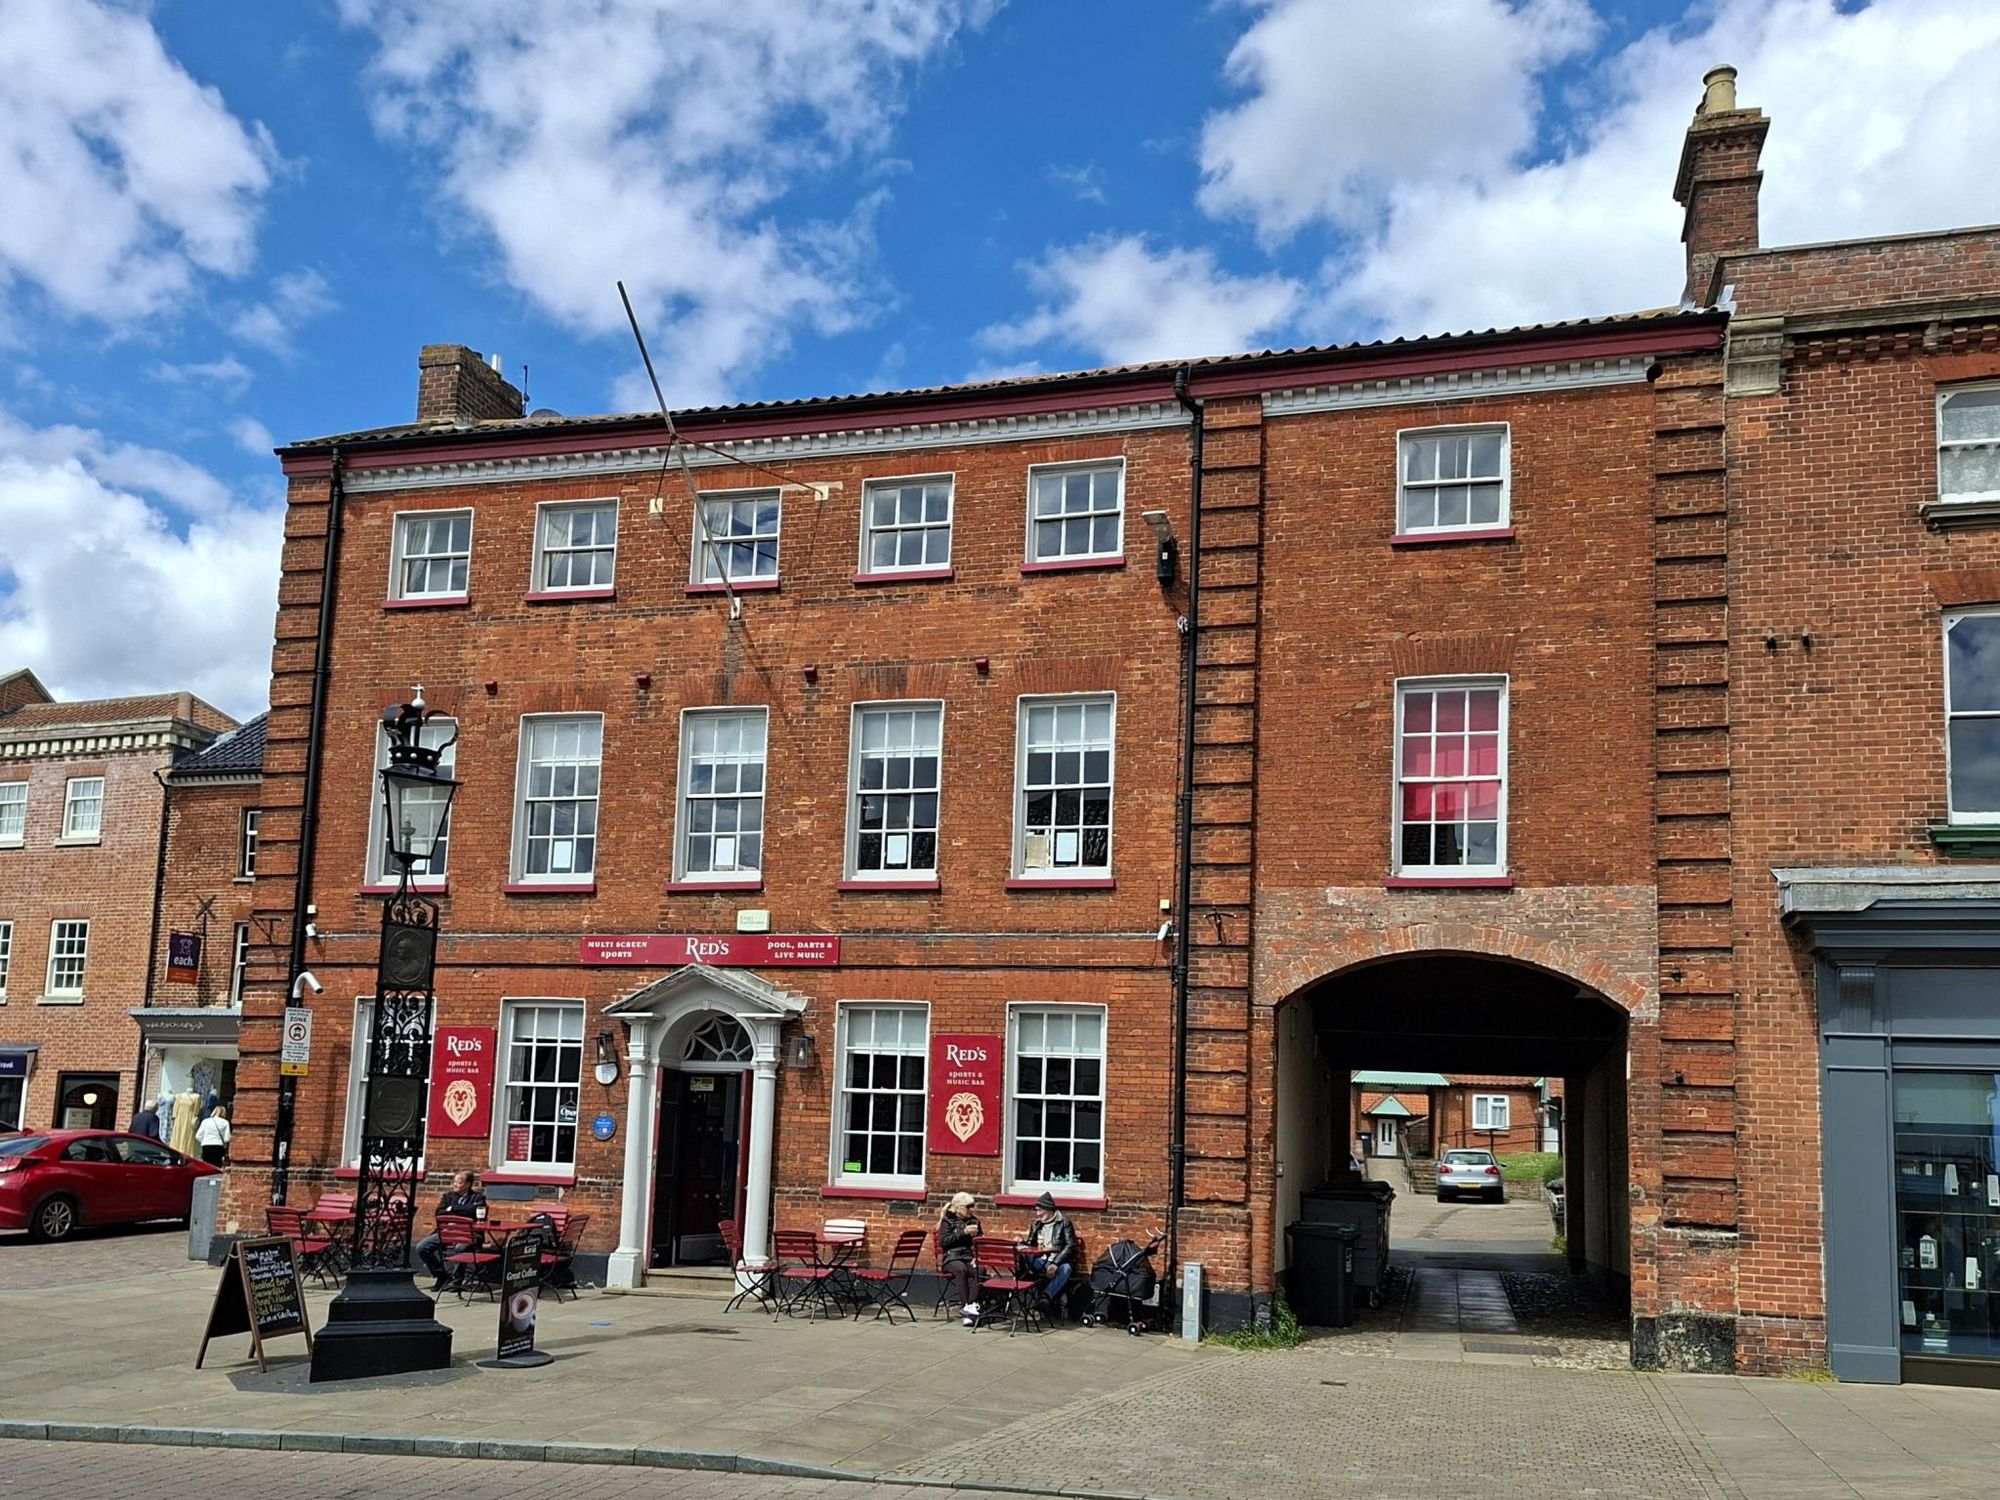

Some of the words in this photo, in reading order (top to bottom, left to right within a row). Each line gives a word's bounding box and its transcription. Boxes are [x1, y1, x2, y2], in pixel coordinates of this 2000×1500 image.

[768, 941, 795, 950] POOL,
[600, 951, 632, 959] SPORTS
[774, 951, 795, 959] LIVE
[948, 1071, 976, 1079] SPORTS
